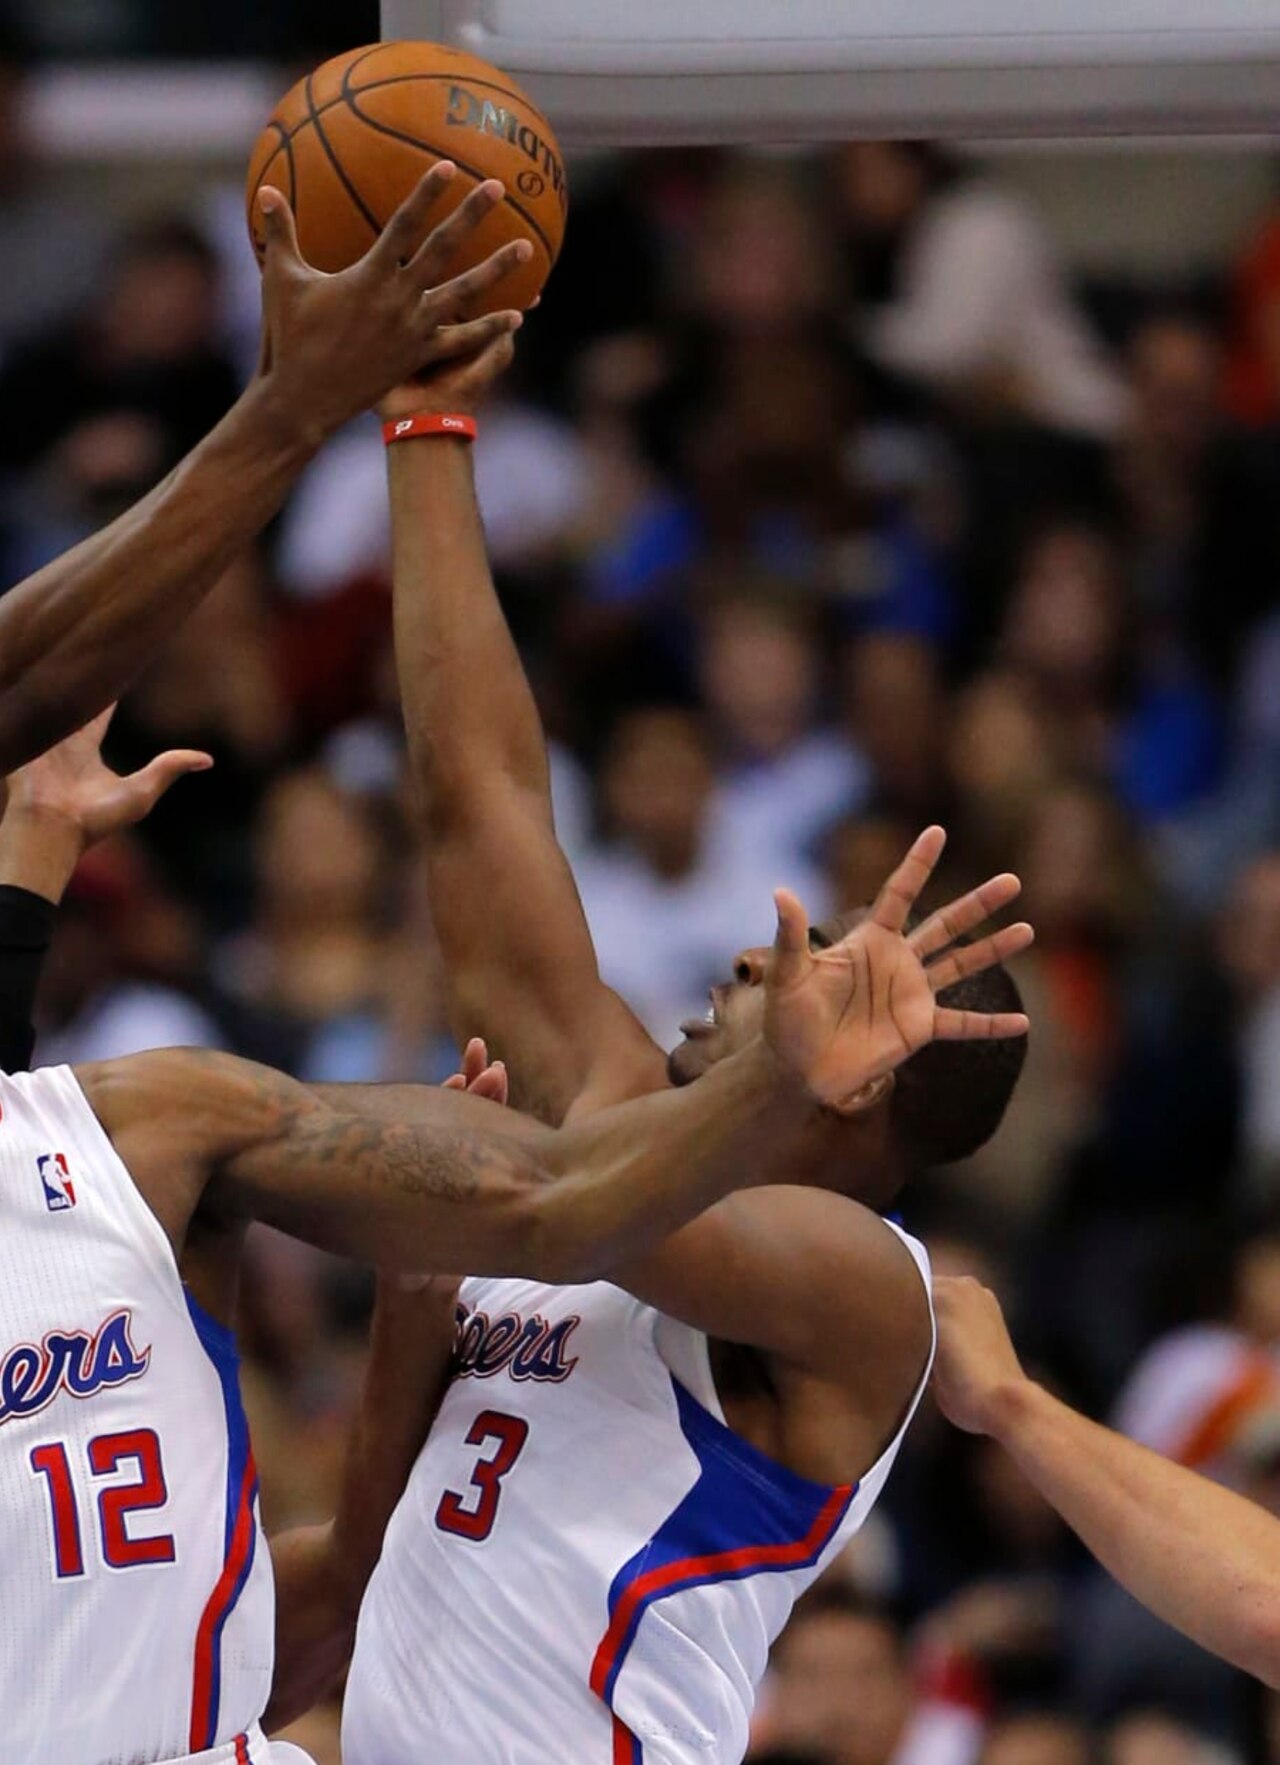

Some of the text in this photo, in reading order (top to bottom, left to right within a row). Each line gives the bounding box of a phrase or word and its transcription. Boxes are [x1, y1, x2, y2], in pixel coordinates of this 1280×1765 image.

[447, 86, 566, 210] ALDING
[30, 1427, 176, 1578] 12
[434, 1410, 529, 1541] 3
